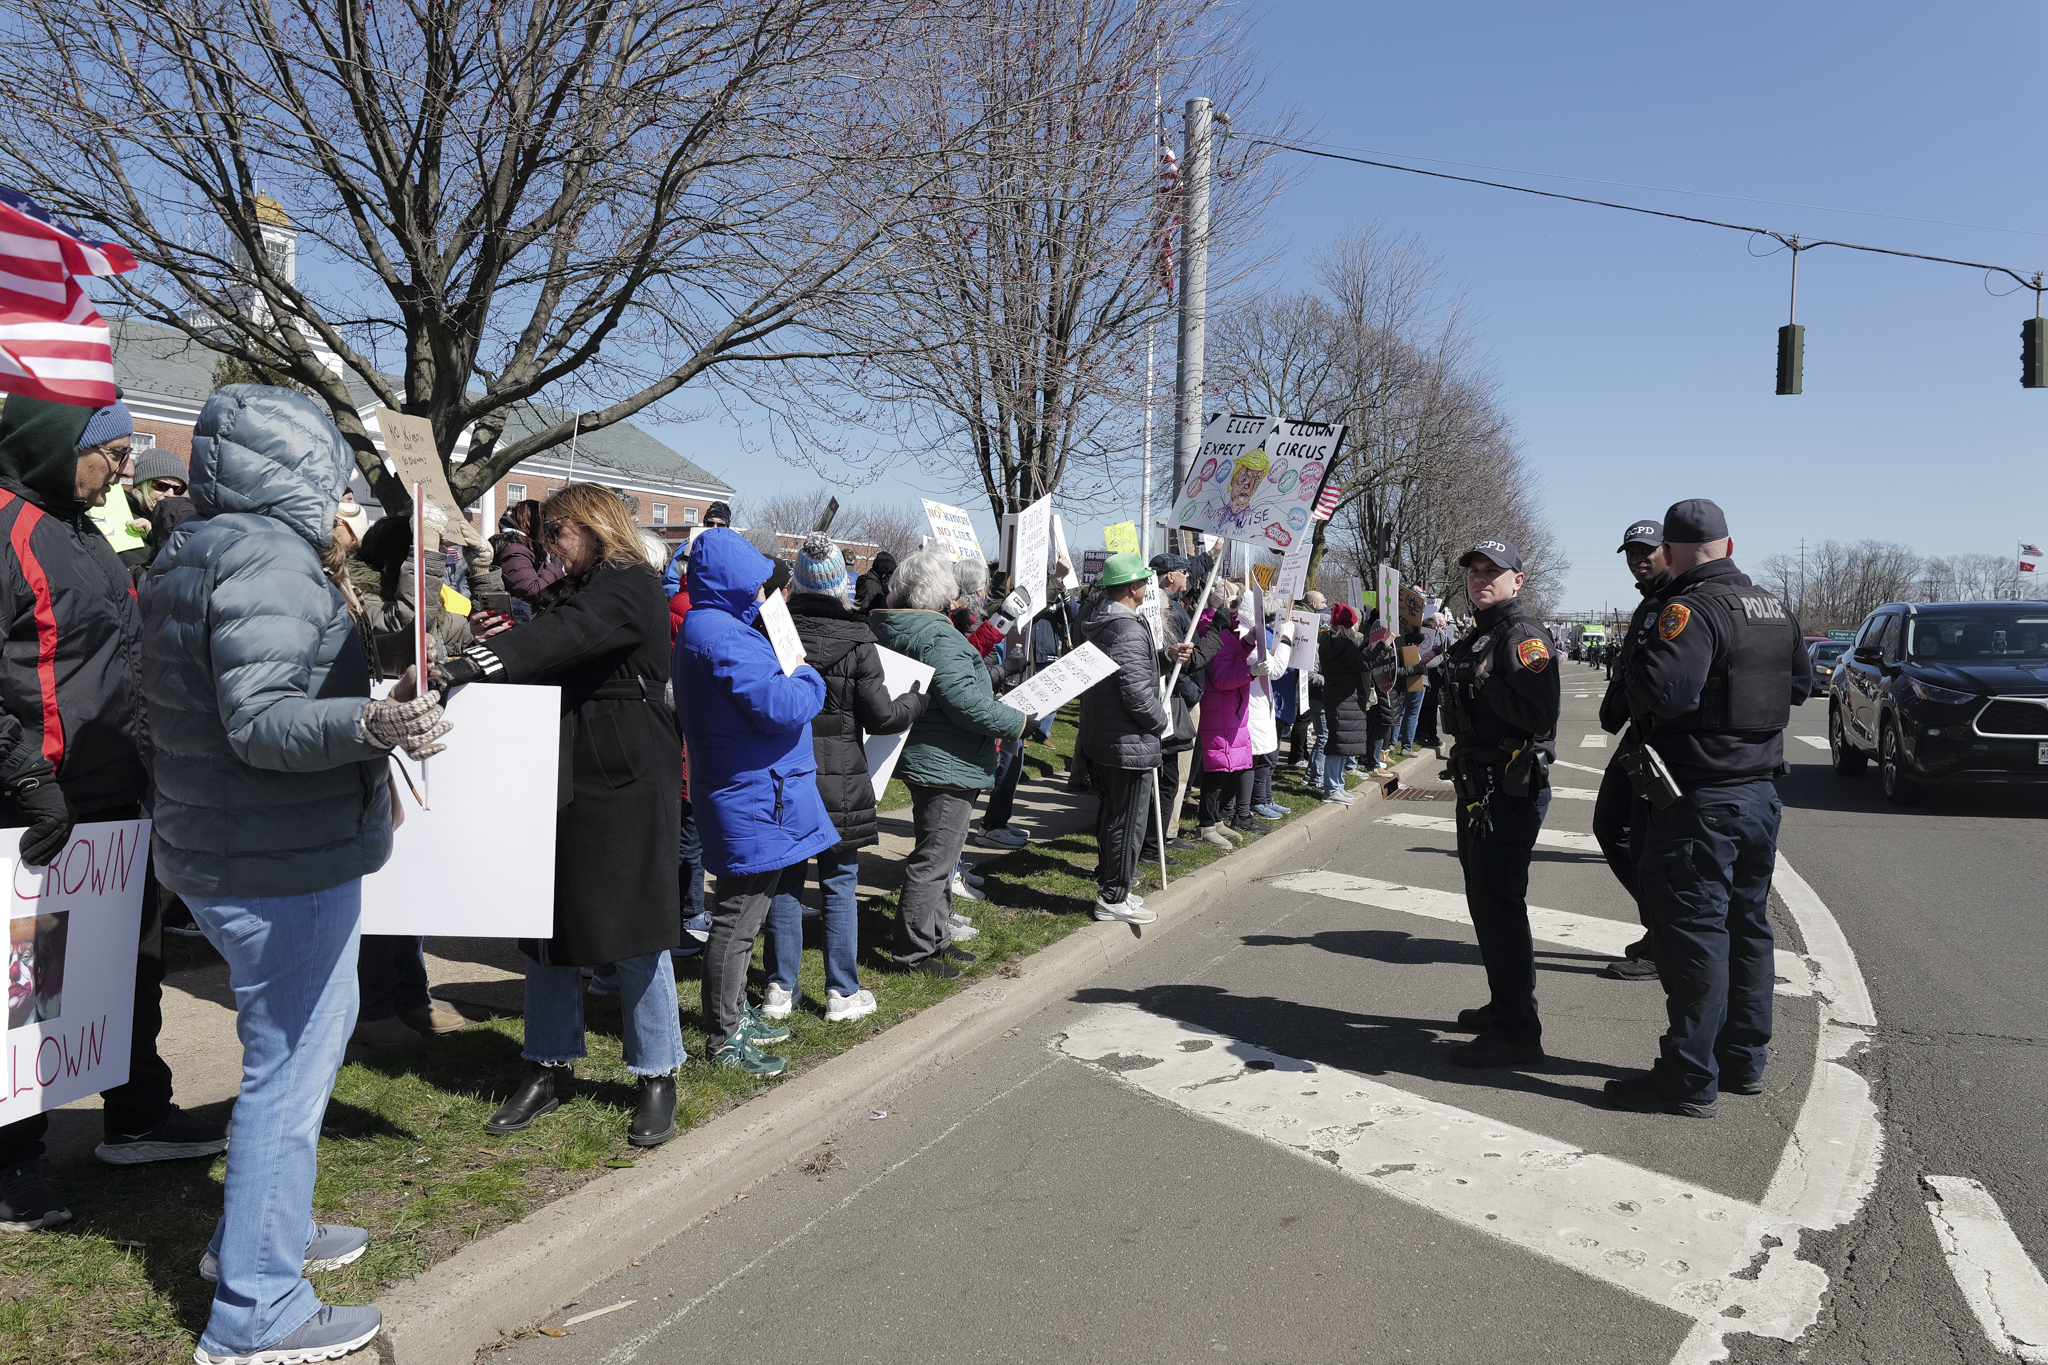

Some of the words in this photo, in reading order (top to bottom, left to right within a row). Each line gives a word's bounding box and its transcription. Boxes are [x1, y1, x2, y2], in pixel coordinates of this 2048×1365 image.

[1226, 419, 1265, 434] ELECT
[1270, 423, 1280, 435] A
[1290, 424, 1335, 437] CLOWN
[1203, 441, 1247, 456] EXPECT
[1258, 439, 1266, 451] A
[1276, 442, 1326, 461] CIRCUS
[927, 508, 941, 519] NO
[943, 512, 970, 526] KINGS
[937, 526, 951, 537] NO
[952, 529, 972, 541] LIES
[1109, 526, 1127, 537] NOT
[1626, 526, 1654, 539] SCPD
[942, 544, 956, 554] NO
[958, 546, 982, 560] FEAR
[1085, 561, 1103, 572] STOP
[1144, 589, 1155, 602] HAS
[1740, 597, 1786, 619] POLICE
[13, 823, 140, 900] CROWN
[0, 1014, 107, 1099] LOWN
